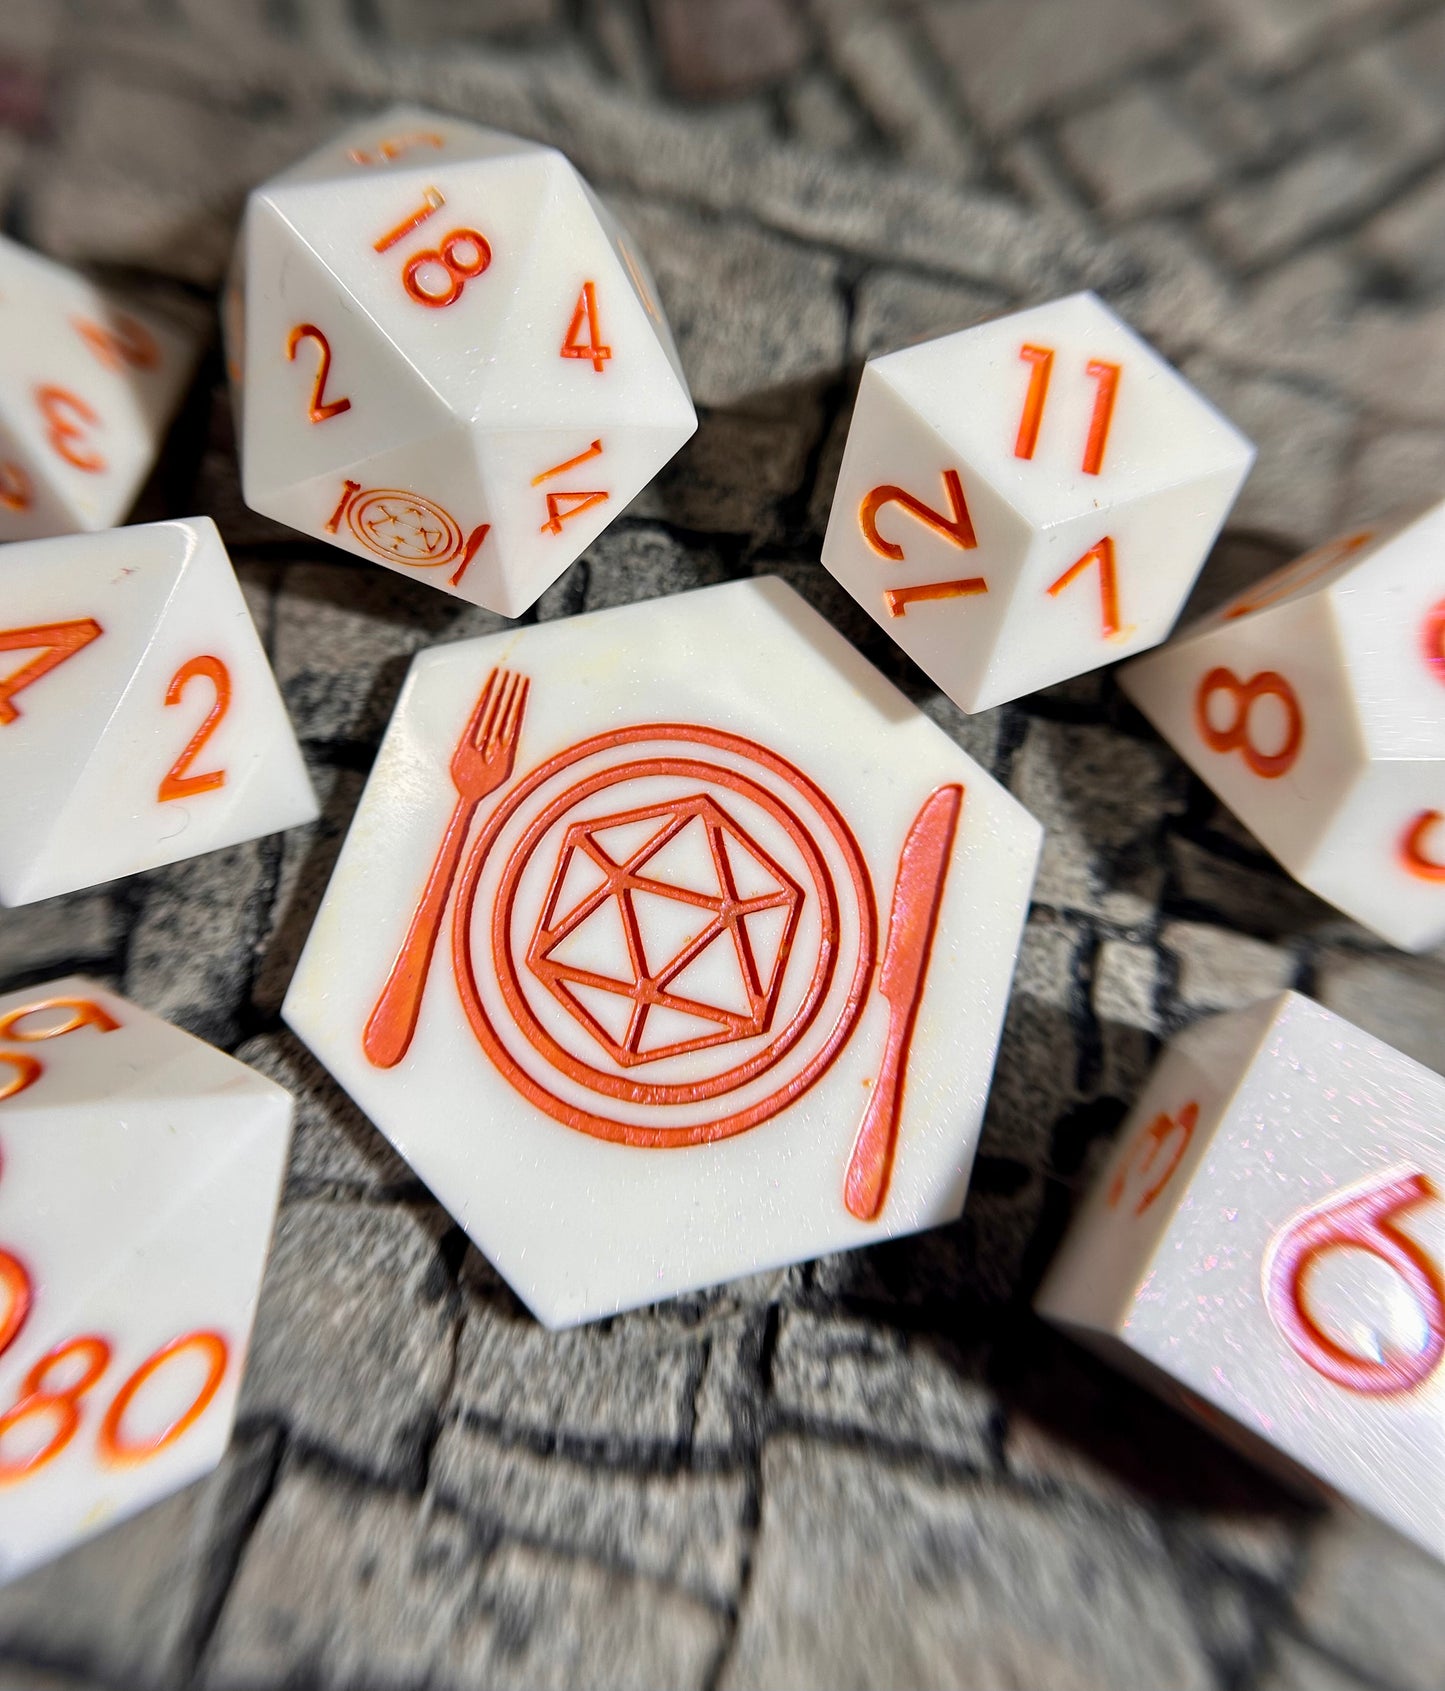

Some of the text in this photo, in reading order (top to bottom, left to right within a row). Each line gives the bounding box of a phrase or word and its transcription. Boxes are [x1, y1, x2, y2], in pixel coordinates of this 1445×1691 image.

[373, 186, 492, 308] 18
[286, 323, 351, 424] 2
[560, 280, 612, 373] 4
[1014, 343, 1122, 476] 11
[531, 440, 609, 536] 14
[859, 468, 988, 618] 12
[157, 655, 232, 803] 2
[1193, 666, 1305, 780] 8
[1264, 1170, 1445, 1396] 6
[0, 1330, 229, 1486] 80
